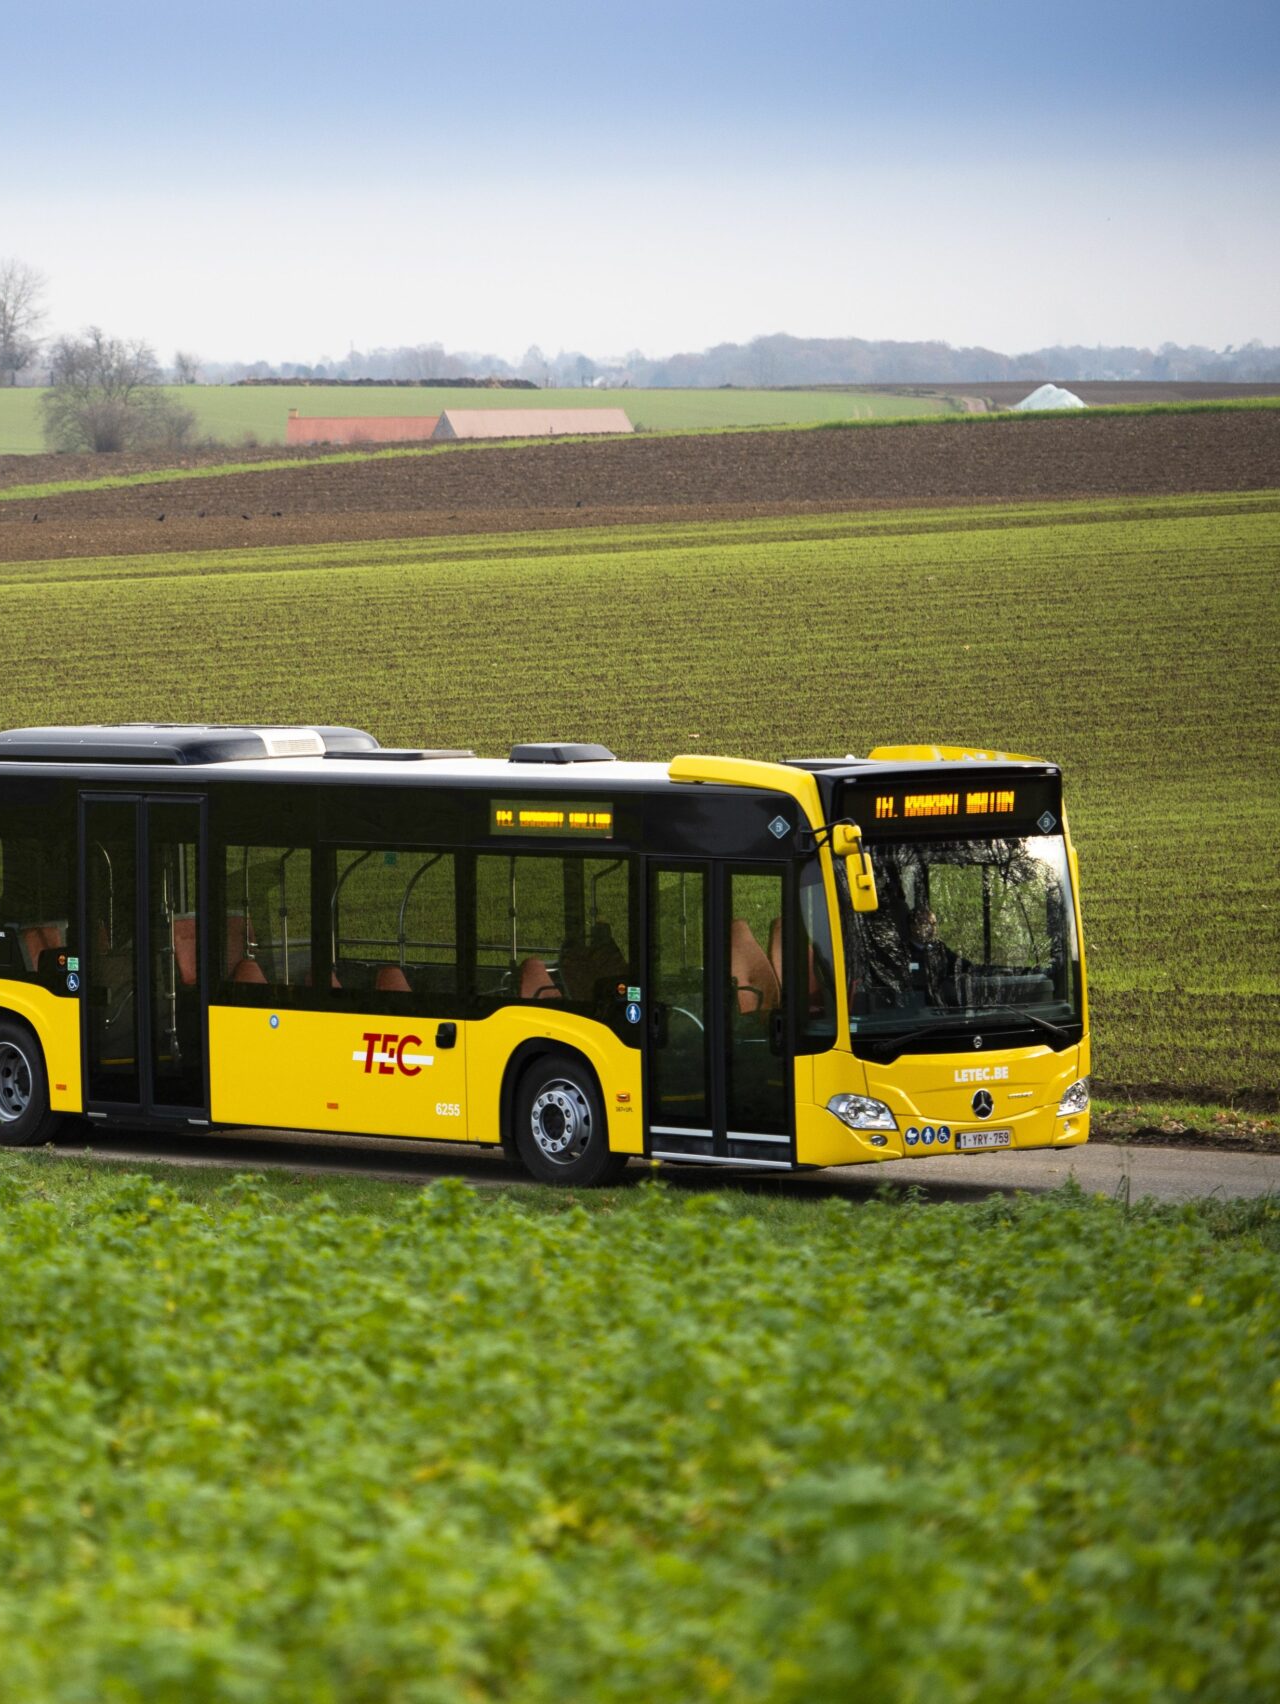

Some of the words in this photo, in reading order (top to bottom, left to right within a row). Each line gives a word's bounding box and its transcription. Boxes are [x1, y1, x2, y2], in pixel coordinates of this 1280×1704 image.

[363, 1032, 423, 1077] TEC
[954, 1067, 1009, 1083] LETEC.BE
[435, 1103, 460, 1116] 6255
